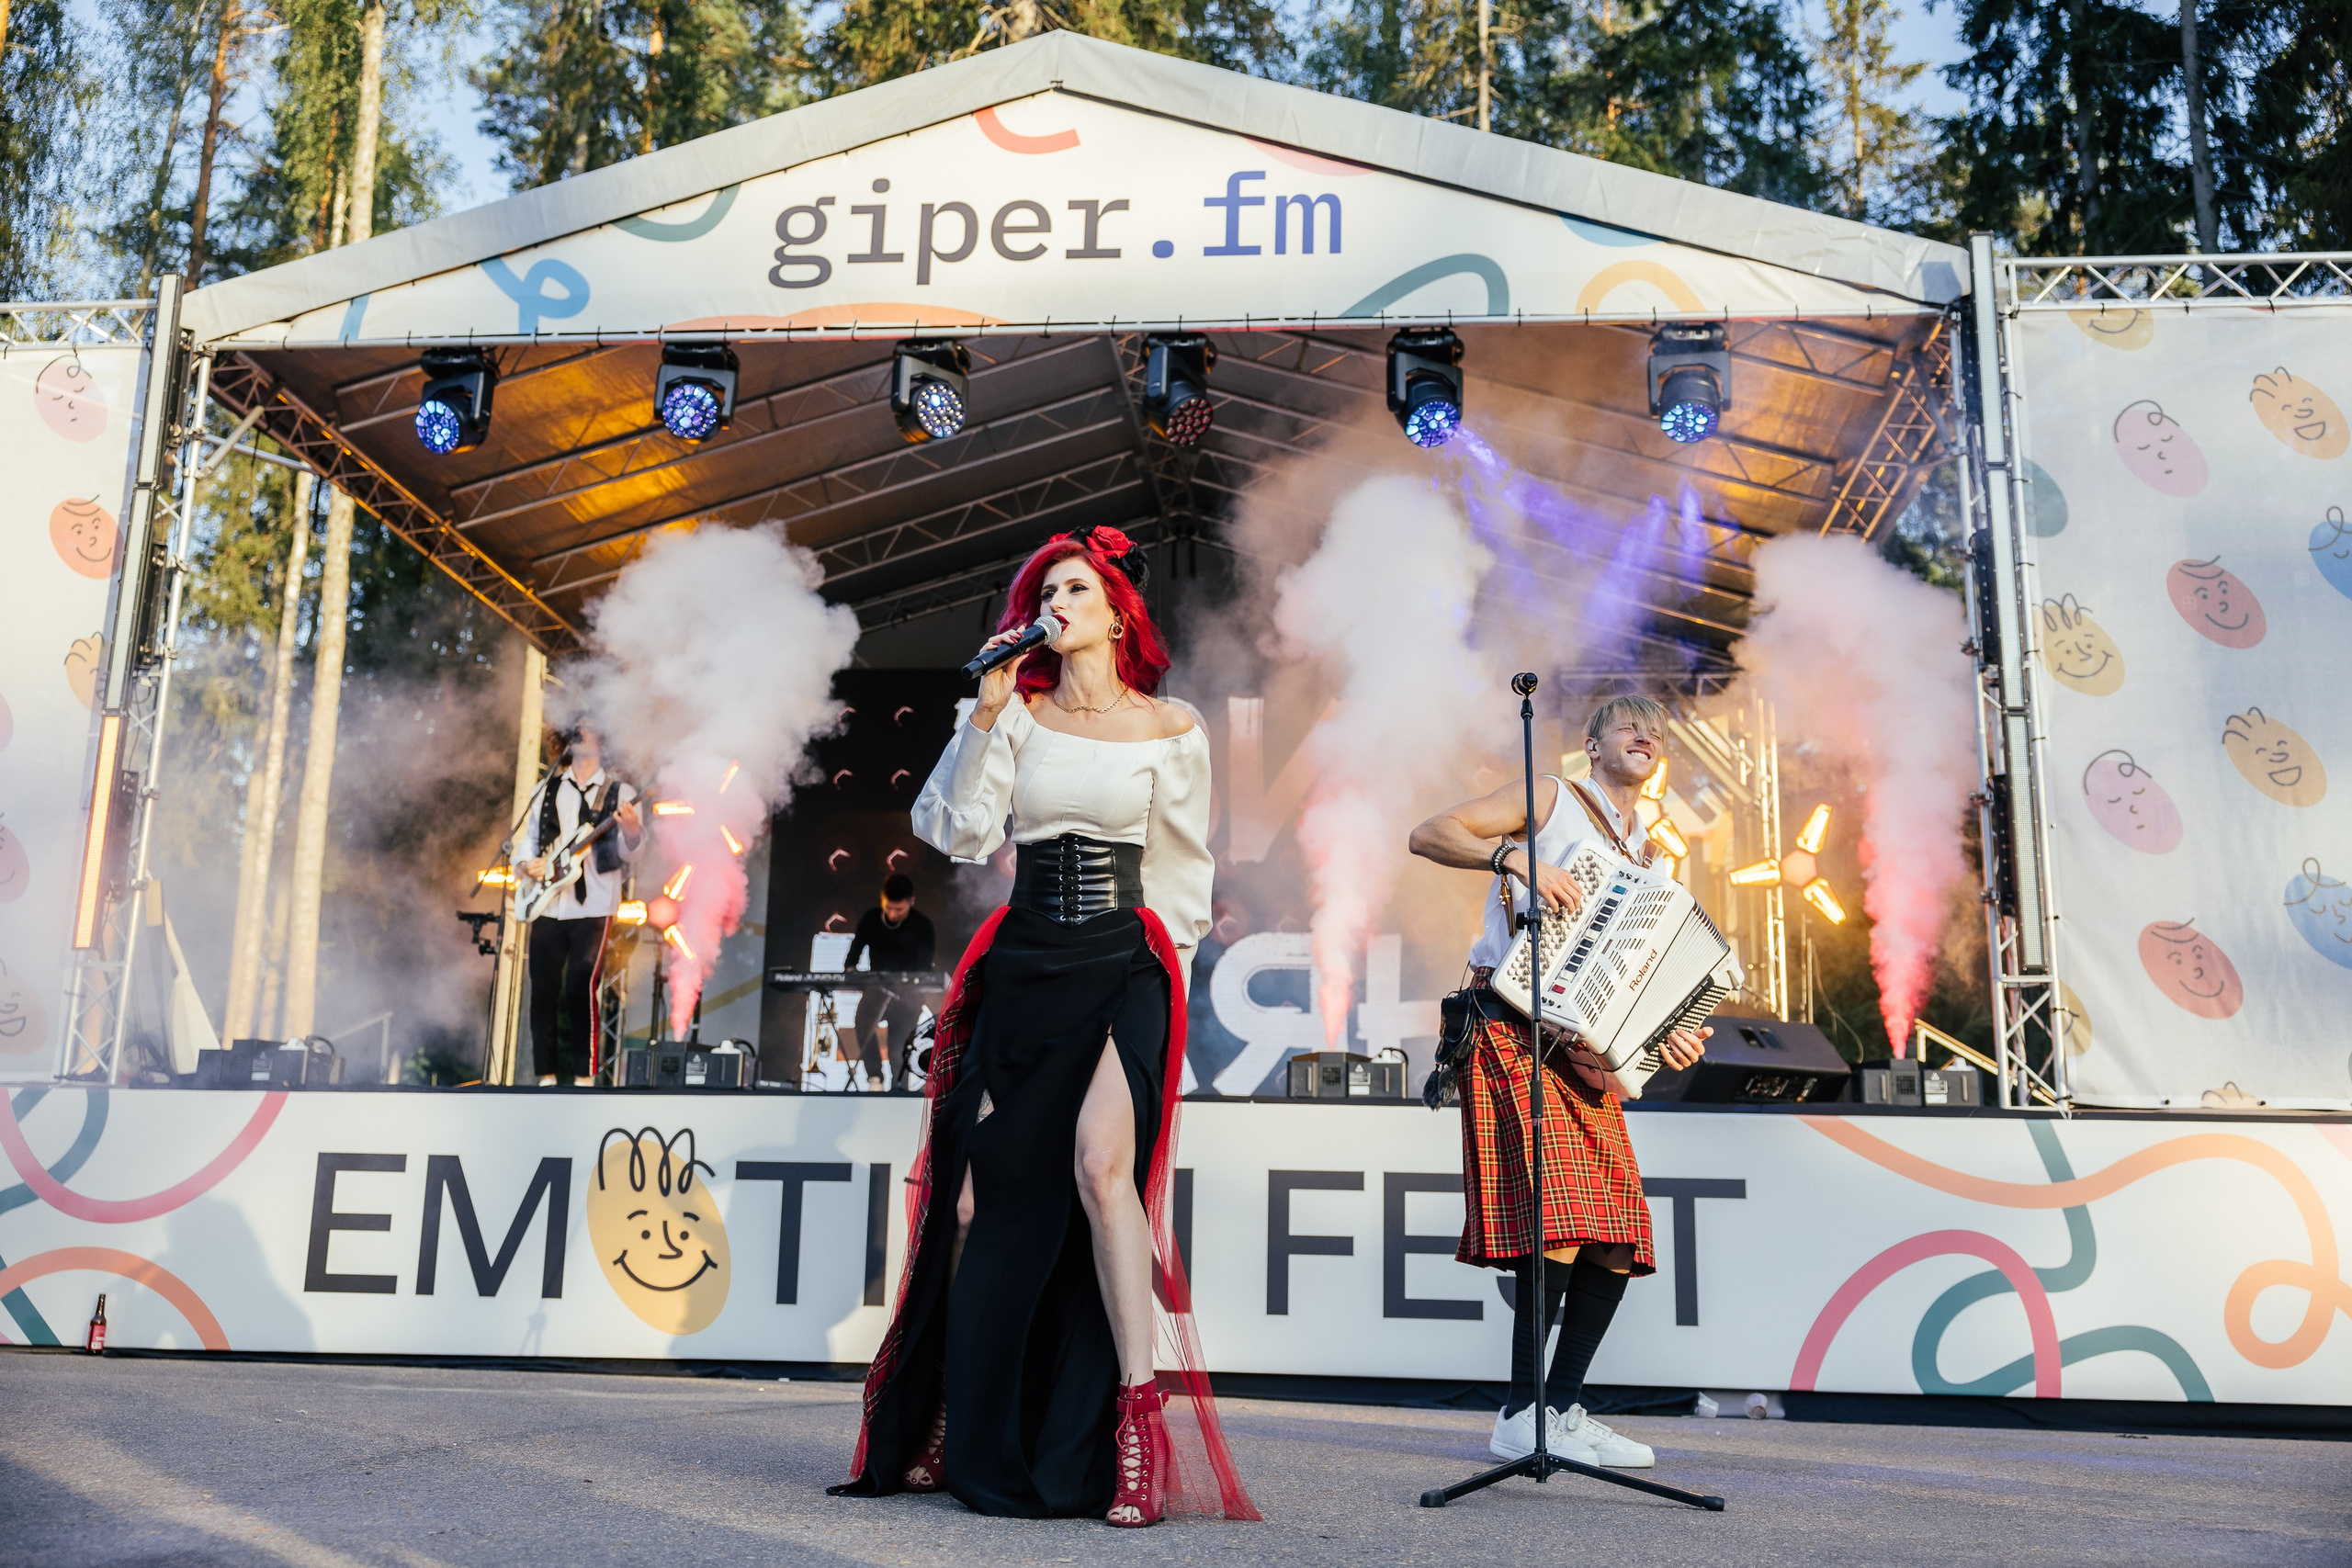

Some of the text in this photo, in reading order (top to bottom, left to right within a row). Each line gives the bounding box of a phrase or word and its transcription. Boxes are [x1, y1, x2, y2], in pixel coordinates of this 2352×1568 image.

[768, 170, 1342, 288] giper.fm
[1629, 948, 1658, 991] Roland
[1266, 1168, 1747, 1326] FET
